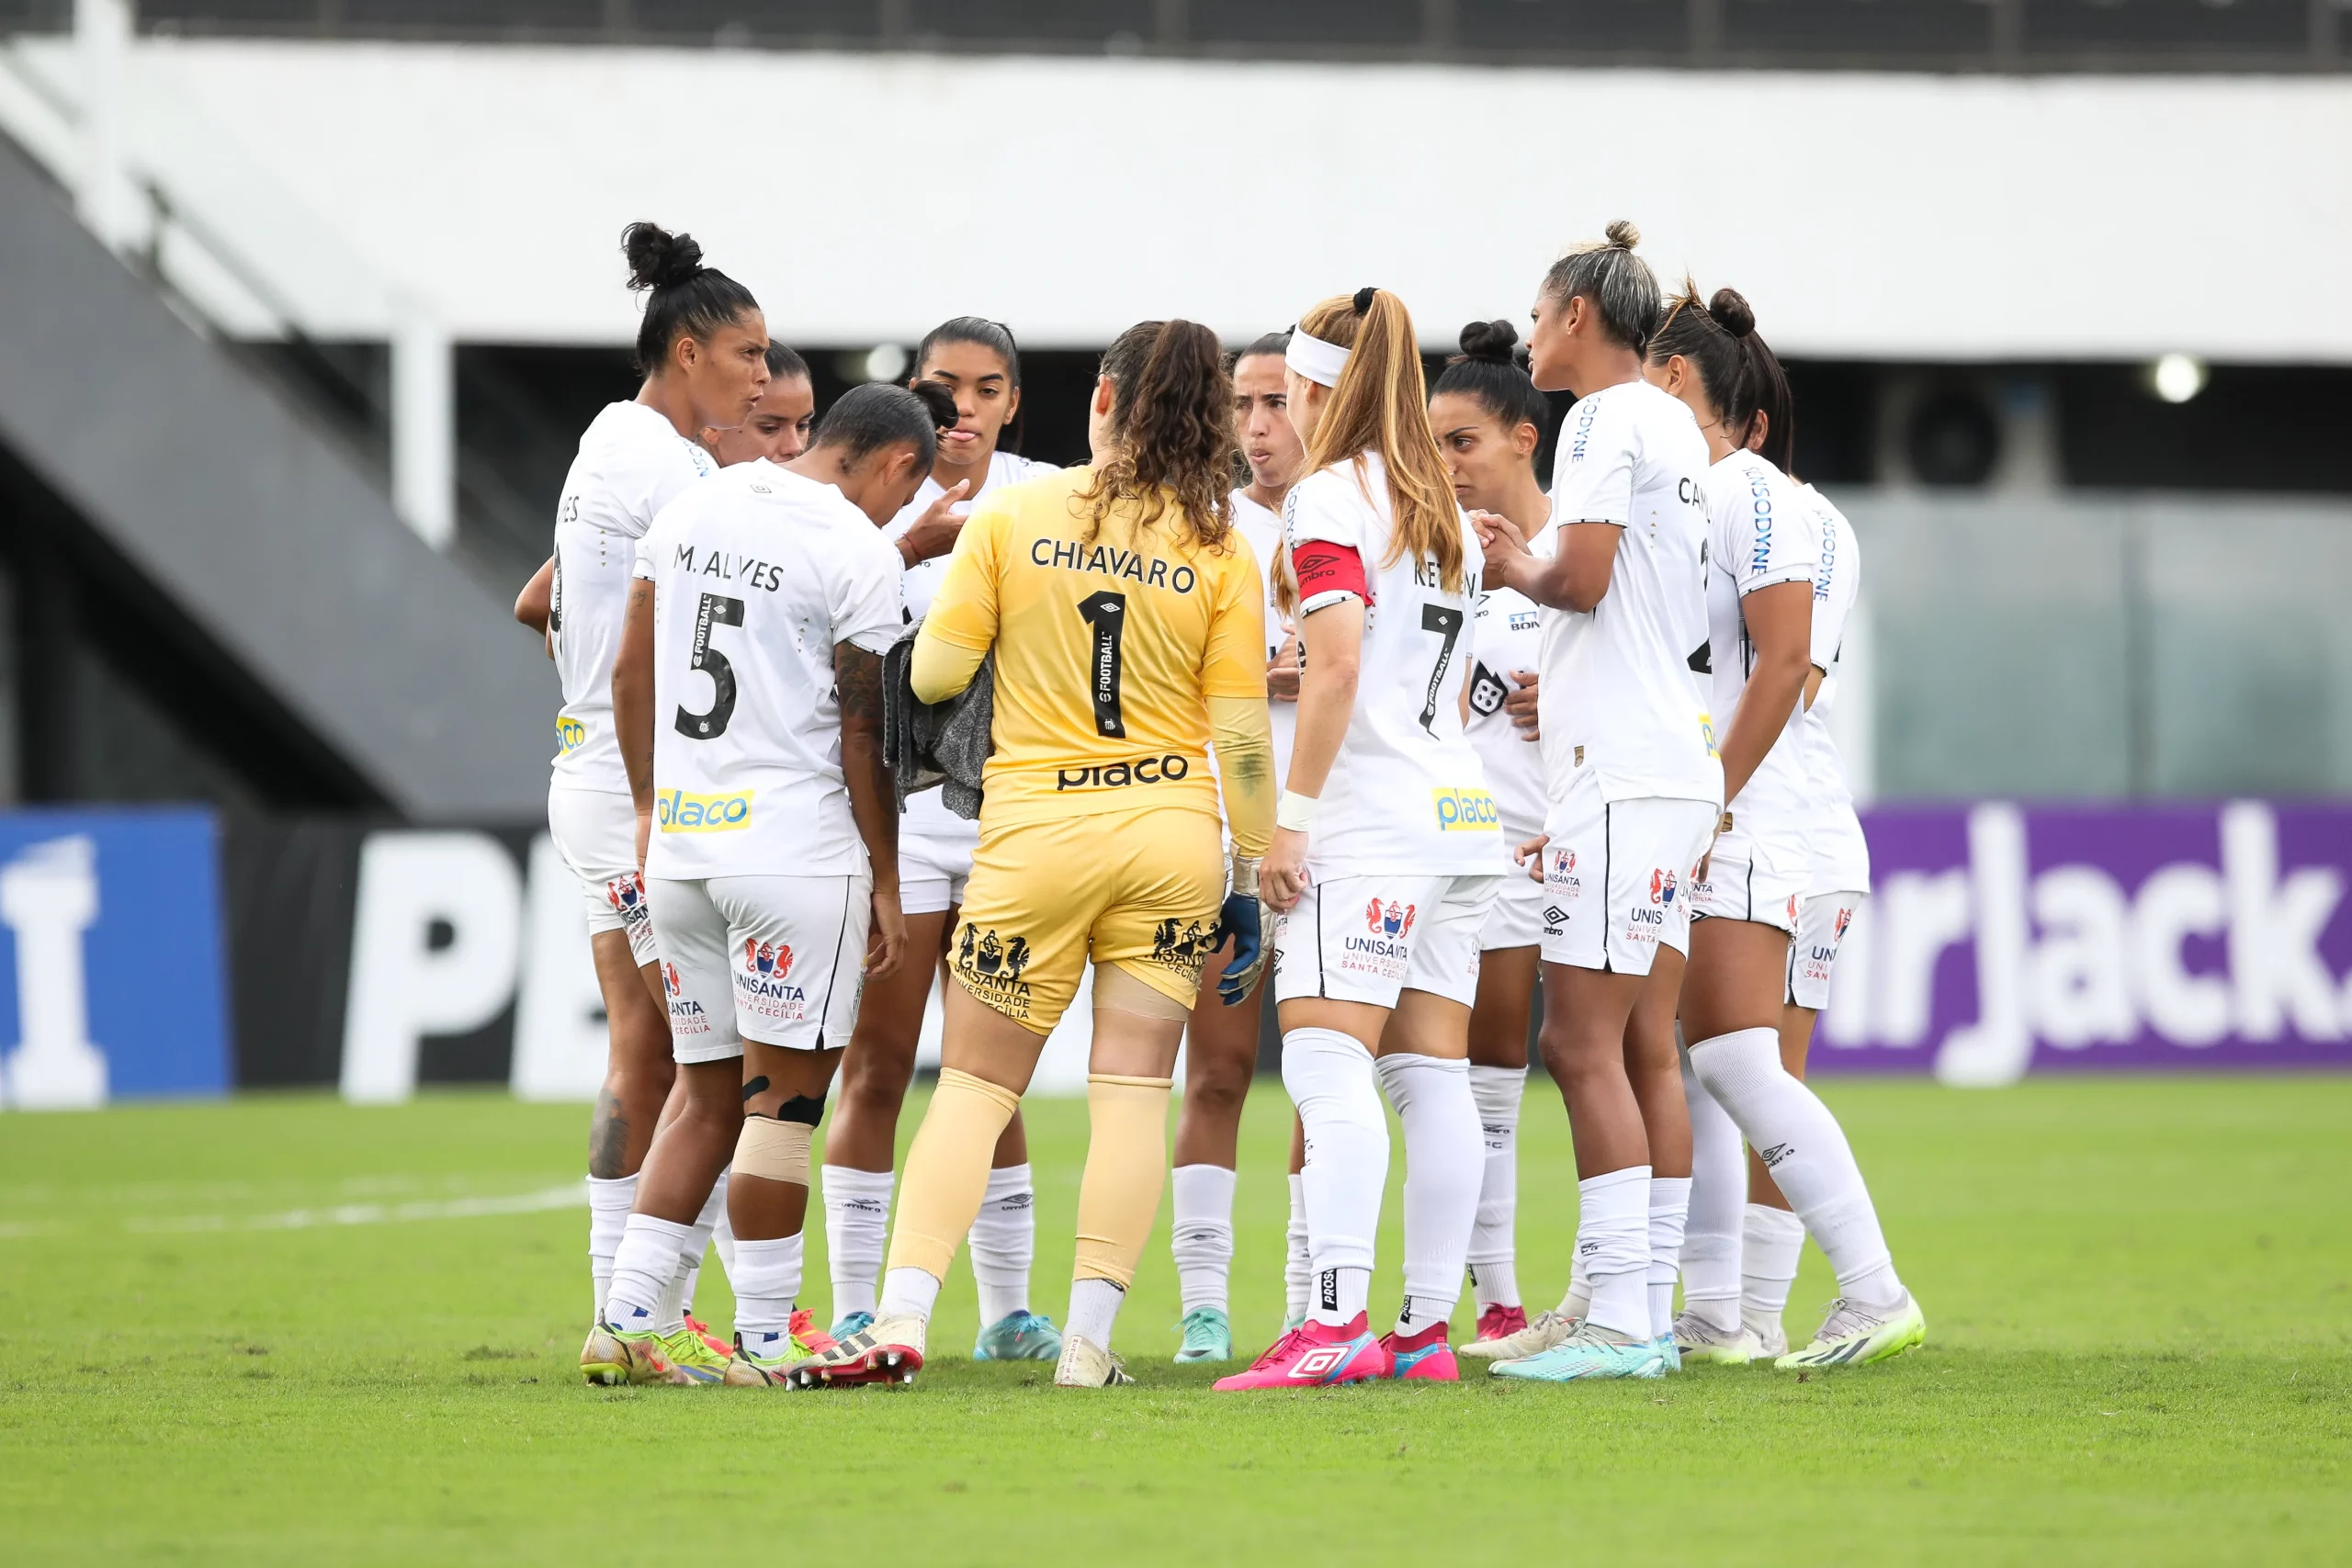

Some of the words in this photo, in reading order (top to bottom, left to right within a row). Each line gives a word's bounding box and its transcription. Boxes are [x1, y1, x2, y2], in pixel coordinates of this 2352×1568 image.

[1742, 467, 1772, 577] SENSODYNE
[673, 544, 696, 573] M.
[703, 551, 784, 592] ALVES
[1031, 538, 1195, 594] CHIAVARO
[674, 592, 745, 740] 5
[1077, 590, 1126, 739] 1
[1419, 603, 1464, 740] 7
[1057, 755, 1190, 791] placo
[1438, 788, 1497, 830] placo
[1341, 961, 1378, 975] SANTA
[1345, 937, 1408, 961] UNISANTA
[735, 971, 805, 1001] UNISANTA
[758, 1007, 804, 1021] CECÍLIA
